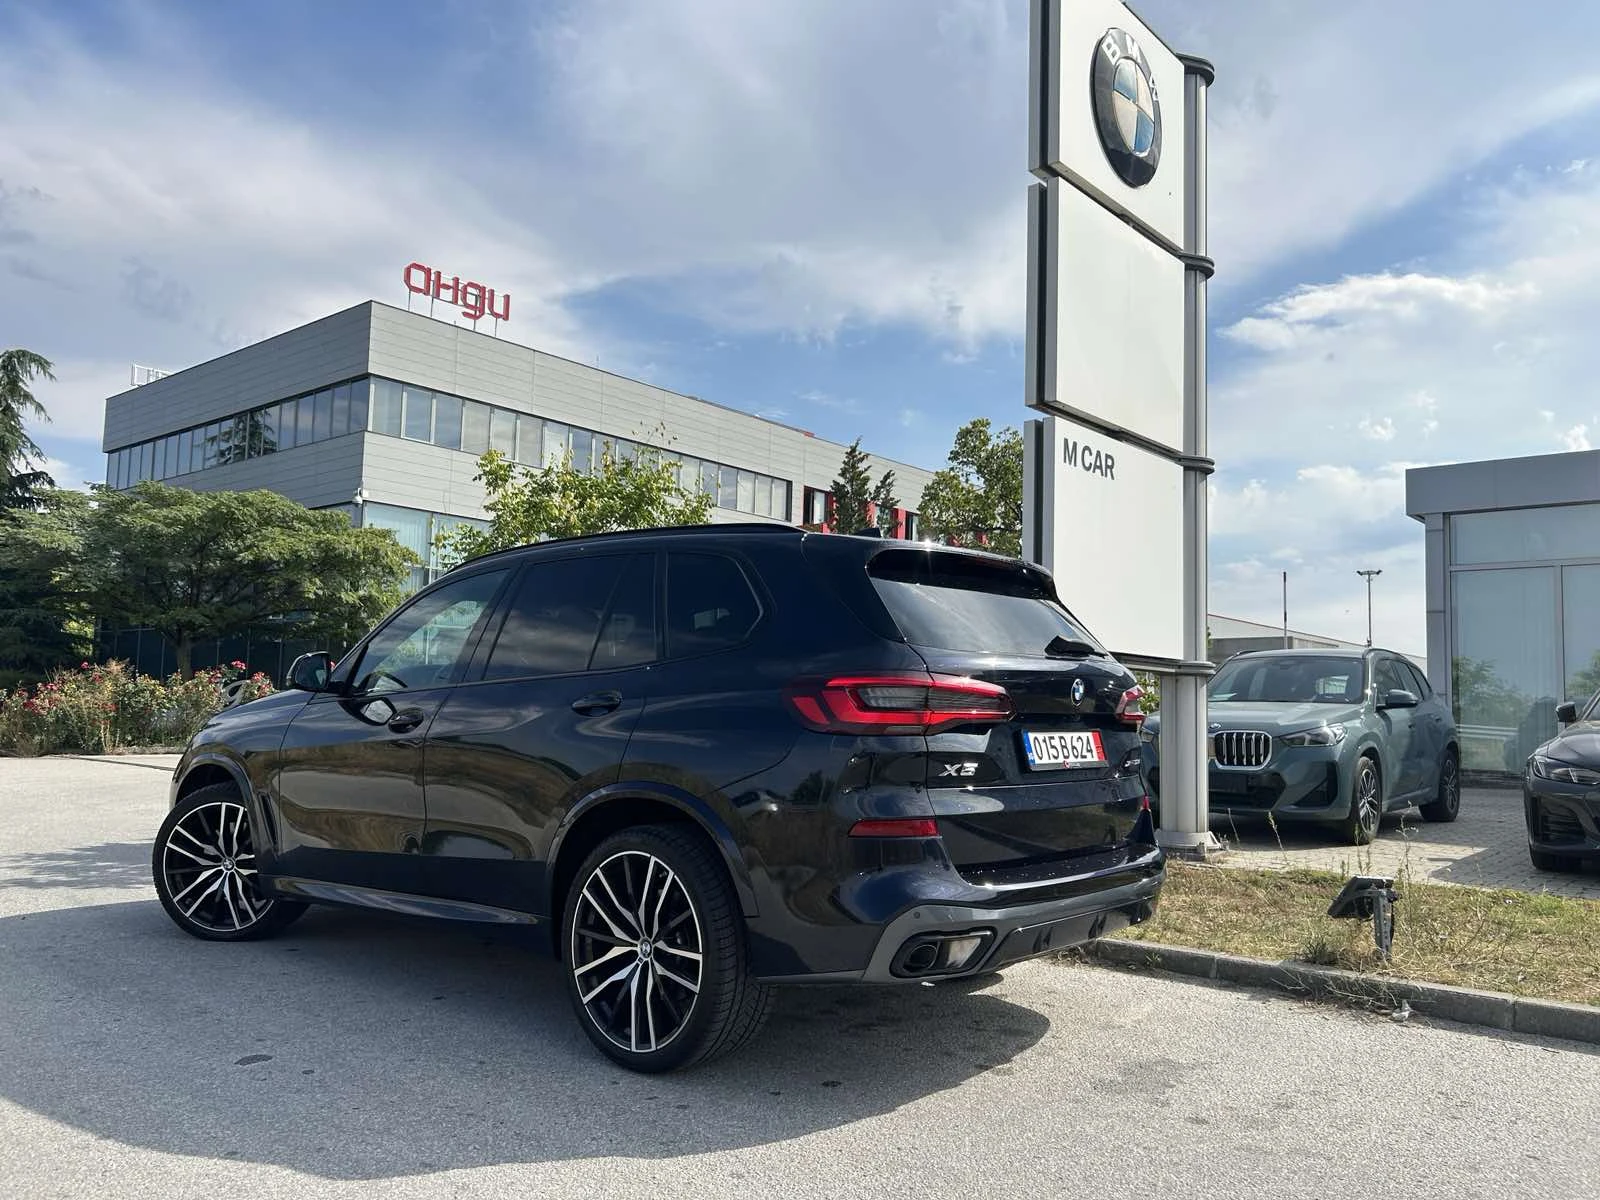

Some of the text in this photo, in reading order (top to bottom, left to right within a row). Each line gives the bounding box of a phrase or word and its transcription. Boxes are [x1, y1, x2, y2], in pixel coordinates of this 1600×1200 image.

[1101, 33, 1159, 101] BMW
[1063, 437, 1115, 480] M CAR
[938, 762, 979, 777] X5
